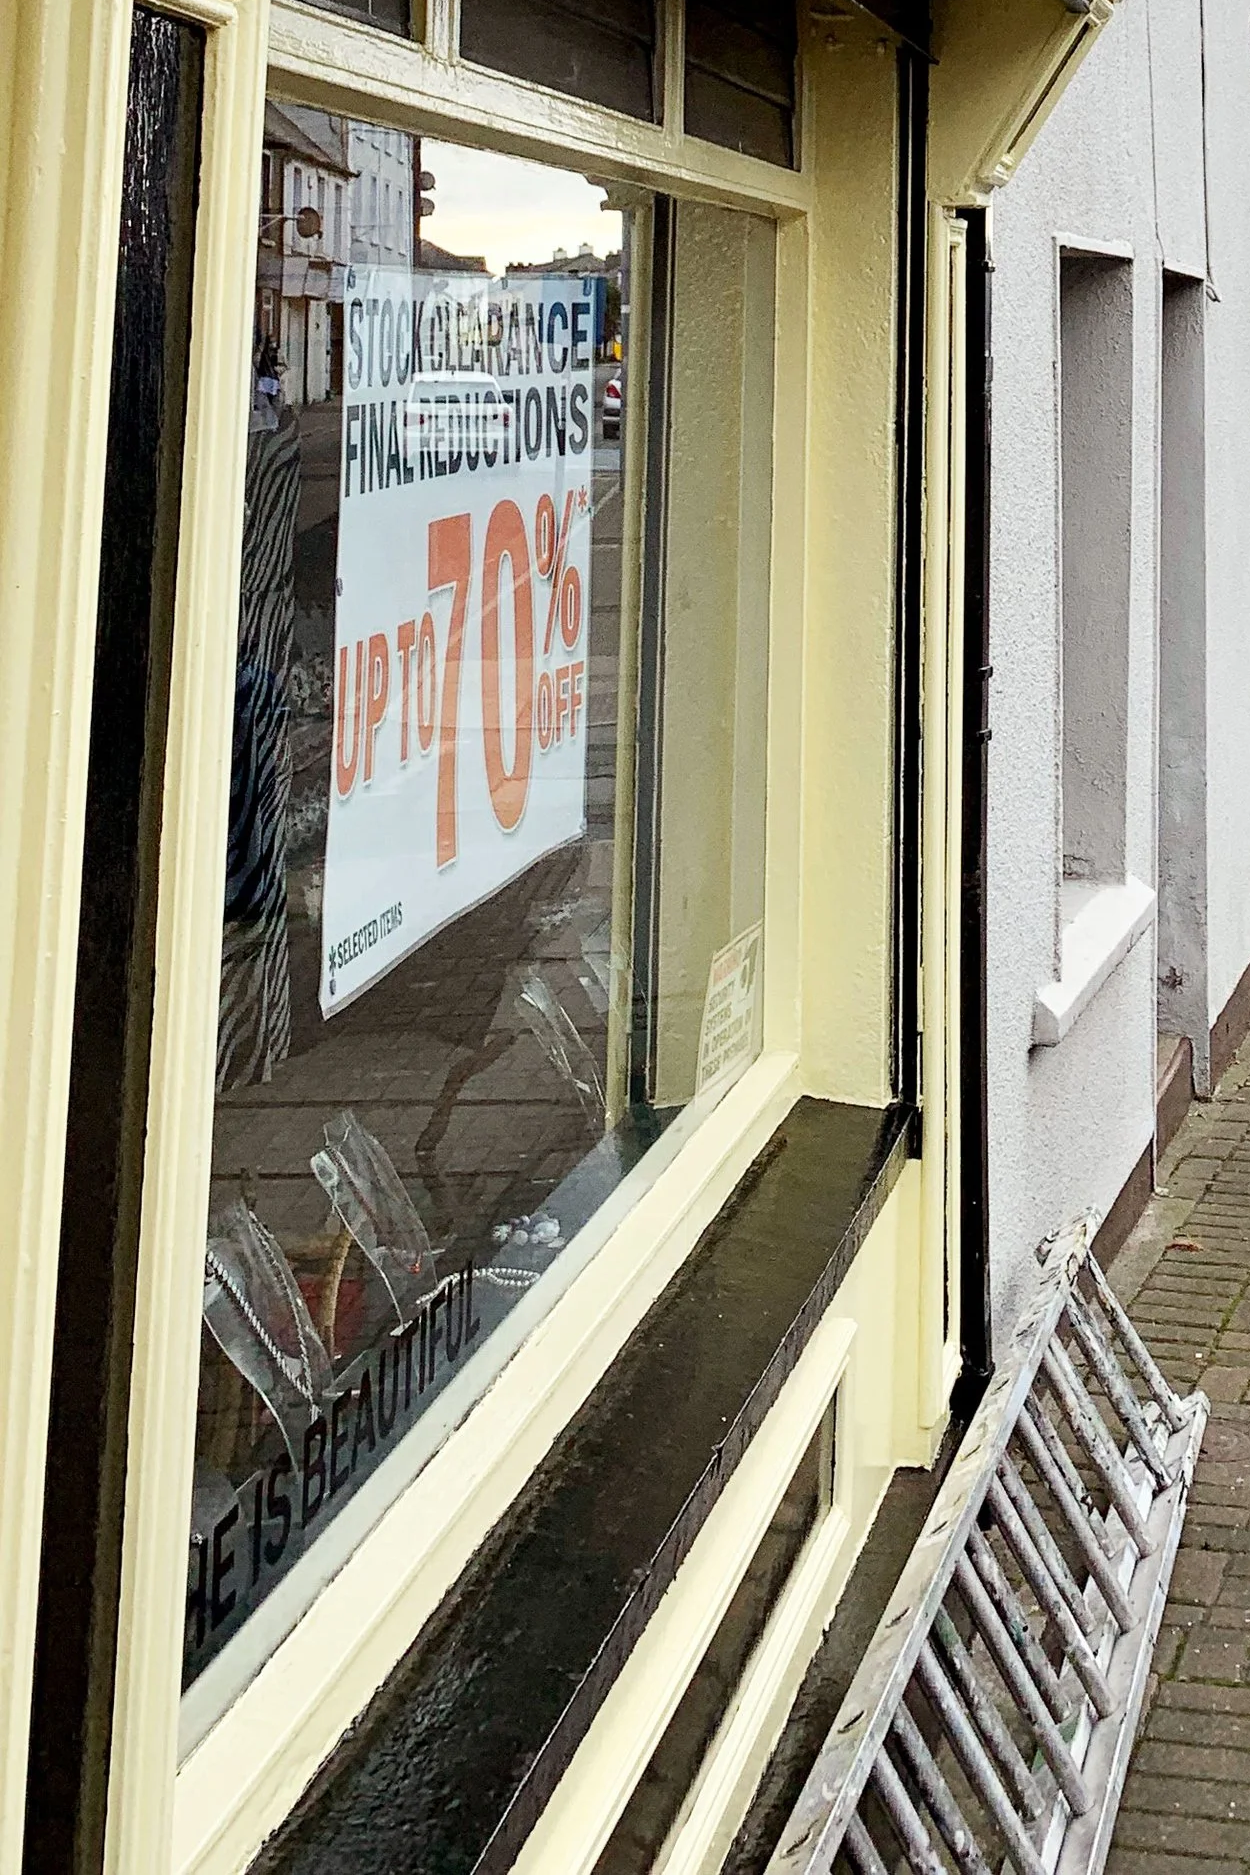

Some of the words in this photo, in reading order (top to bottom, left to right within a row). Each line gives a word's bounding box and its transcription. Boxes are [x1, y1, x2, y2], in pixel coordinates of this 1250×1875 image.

[348, 297, 423, 391] STOCK
[429, 300, 590, 376] CLEARANCE
[345, 398, 414, 498] FINAL
[419, 382, 589, 481] REDUCTIONS
[336, 632, 390, 797] UP
[397, 610, 436, 766] TO
[536, 659, 585, 751] OFF
[379, 901, 403, 940] ITEMS
[252, 1451, 292, 1588] IS
[302, 1259, 481, 1531] BEAUTIFUL
